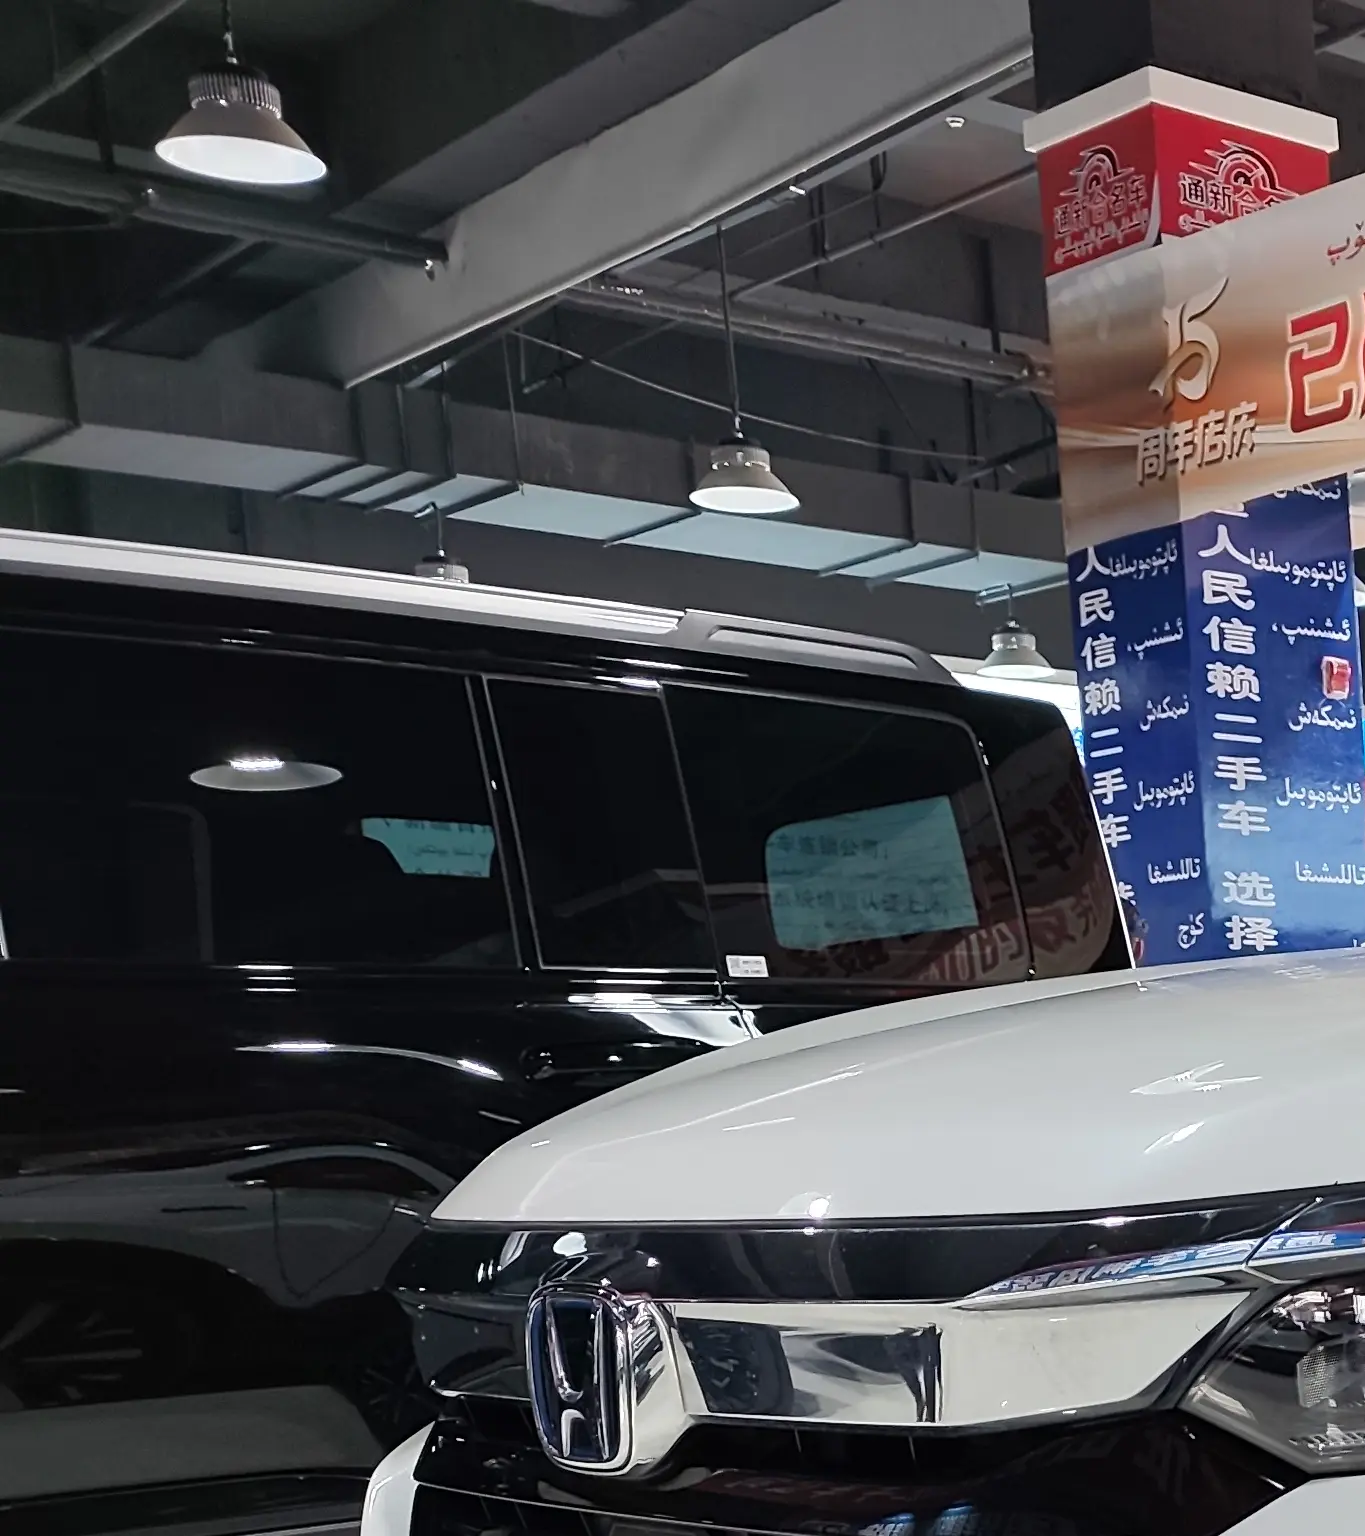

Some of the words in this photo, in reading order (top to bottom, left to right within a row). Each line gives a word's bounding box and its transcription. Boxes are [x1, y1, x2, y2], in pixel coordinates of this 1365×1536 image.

[1179, 172, 1281, 216] 通新合
[1137, 402, 1258, 487] 周年店庆
[1198, 503, 1271, 836] 人民信赖二手车
